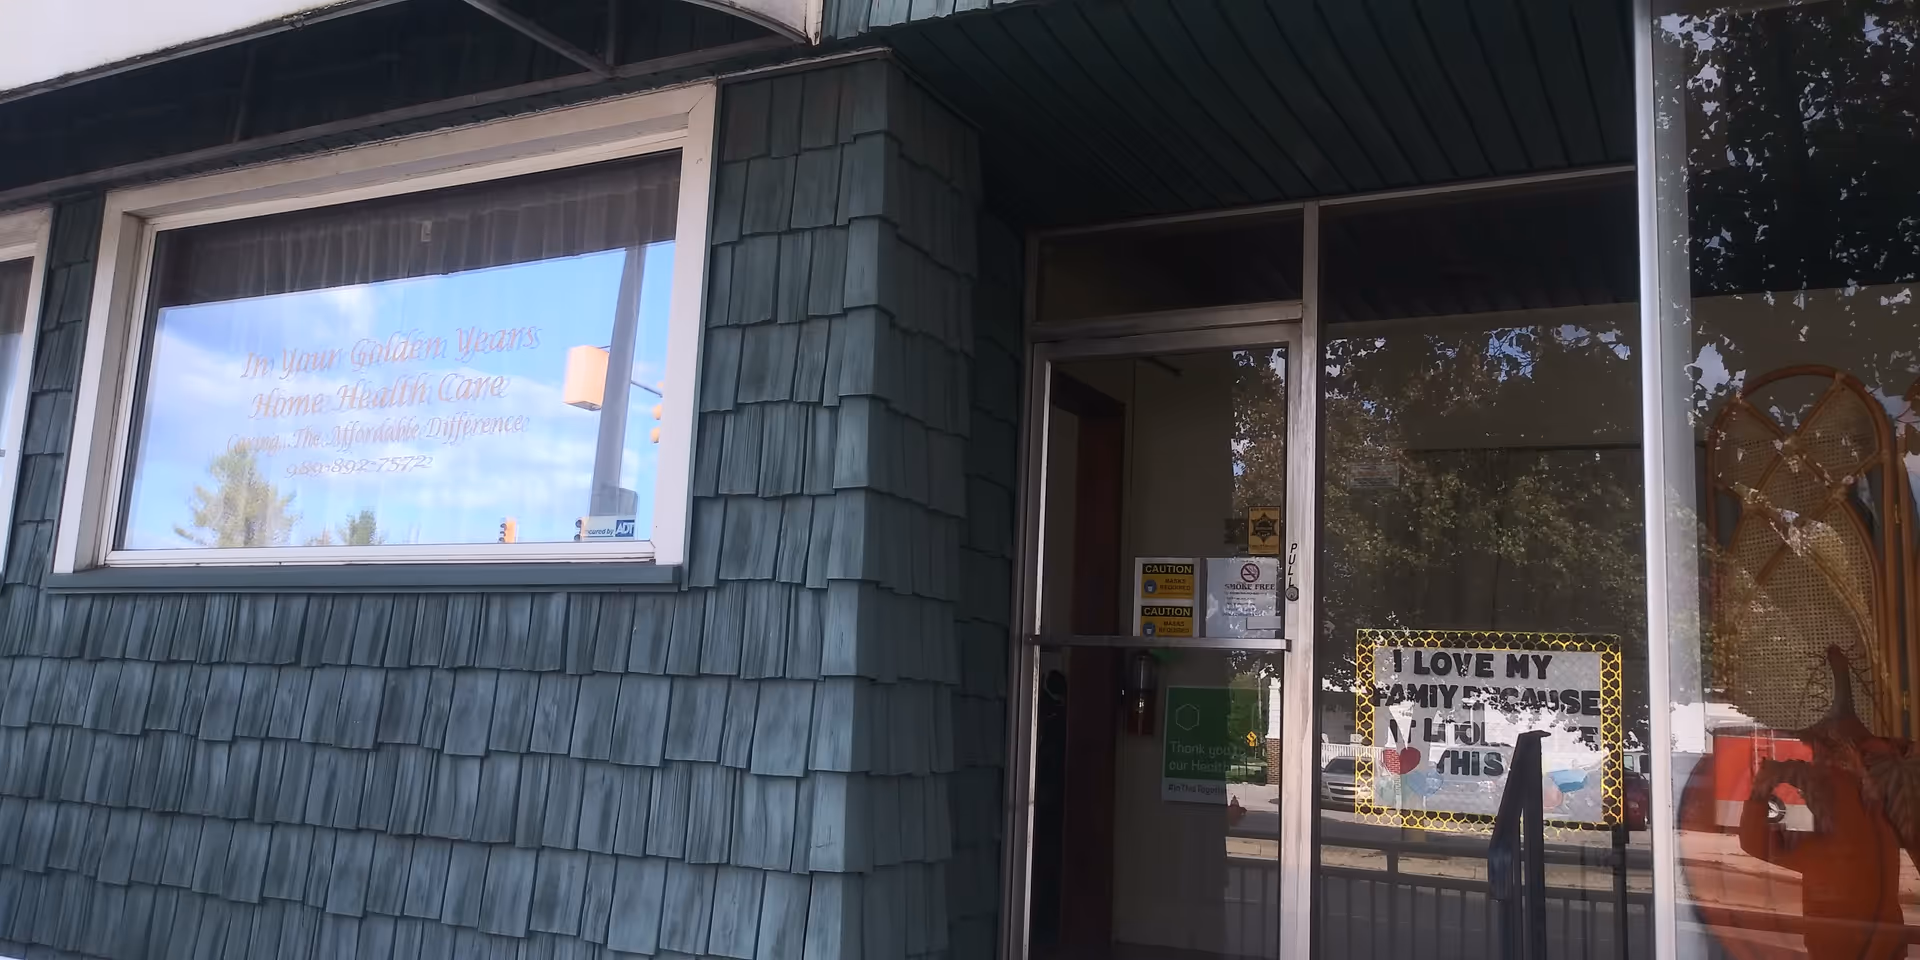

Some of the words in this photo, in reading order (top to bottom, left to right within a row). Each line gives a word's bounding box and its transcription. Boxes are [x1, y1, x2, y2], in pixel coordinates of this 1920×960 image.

[240, 351, 271, 379] In
[279, 346, 342, 380] Your
[350, 328, 443, 372] Golden
[455, 325, 540, 362] Years
[248, 386, 324, 420] Home
[333, 372, 427, 412] Health
[438, 371, 506, 404] Care
[325, 416, 421, 452] Affordable
[426, 411, 526, 444] Difference
[285, 455, 432, 479] 989-892-7572
[606, 528, 614, 536] by
[615, 521, 635, 535] ADT
[1145, 564, 1192, 574] CAUTION
[1287, 543, 1298, 588] PULL
[1224, 583, 1253, 591] SMOKE
[1254, 583, 1276, 591] FREE
[1144, 607, 1191, 616] CAUTION
[1393, 649, 1402, 673] I
[1413, 650, 1494, 678] LOVE
[1506, 653, 1553, 680] MY
[1169, 740, 1205, 754] Thank
[1169, 761, 1188, 771] our
